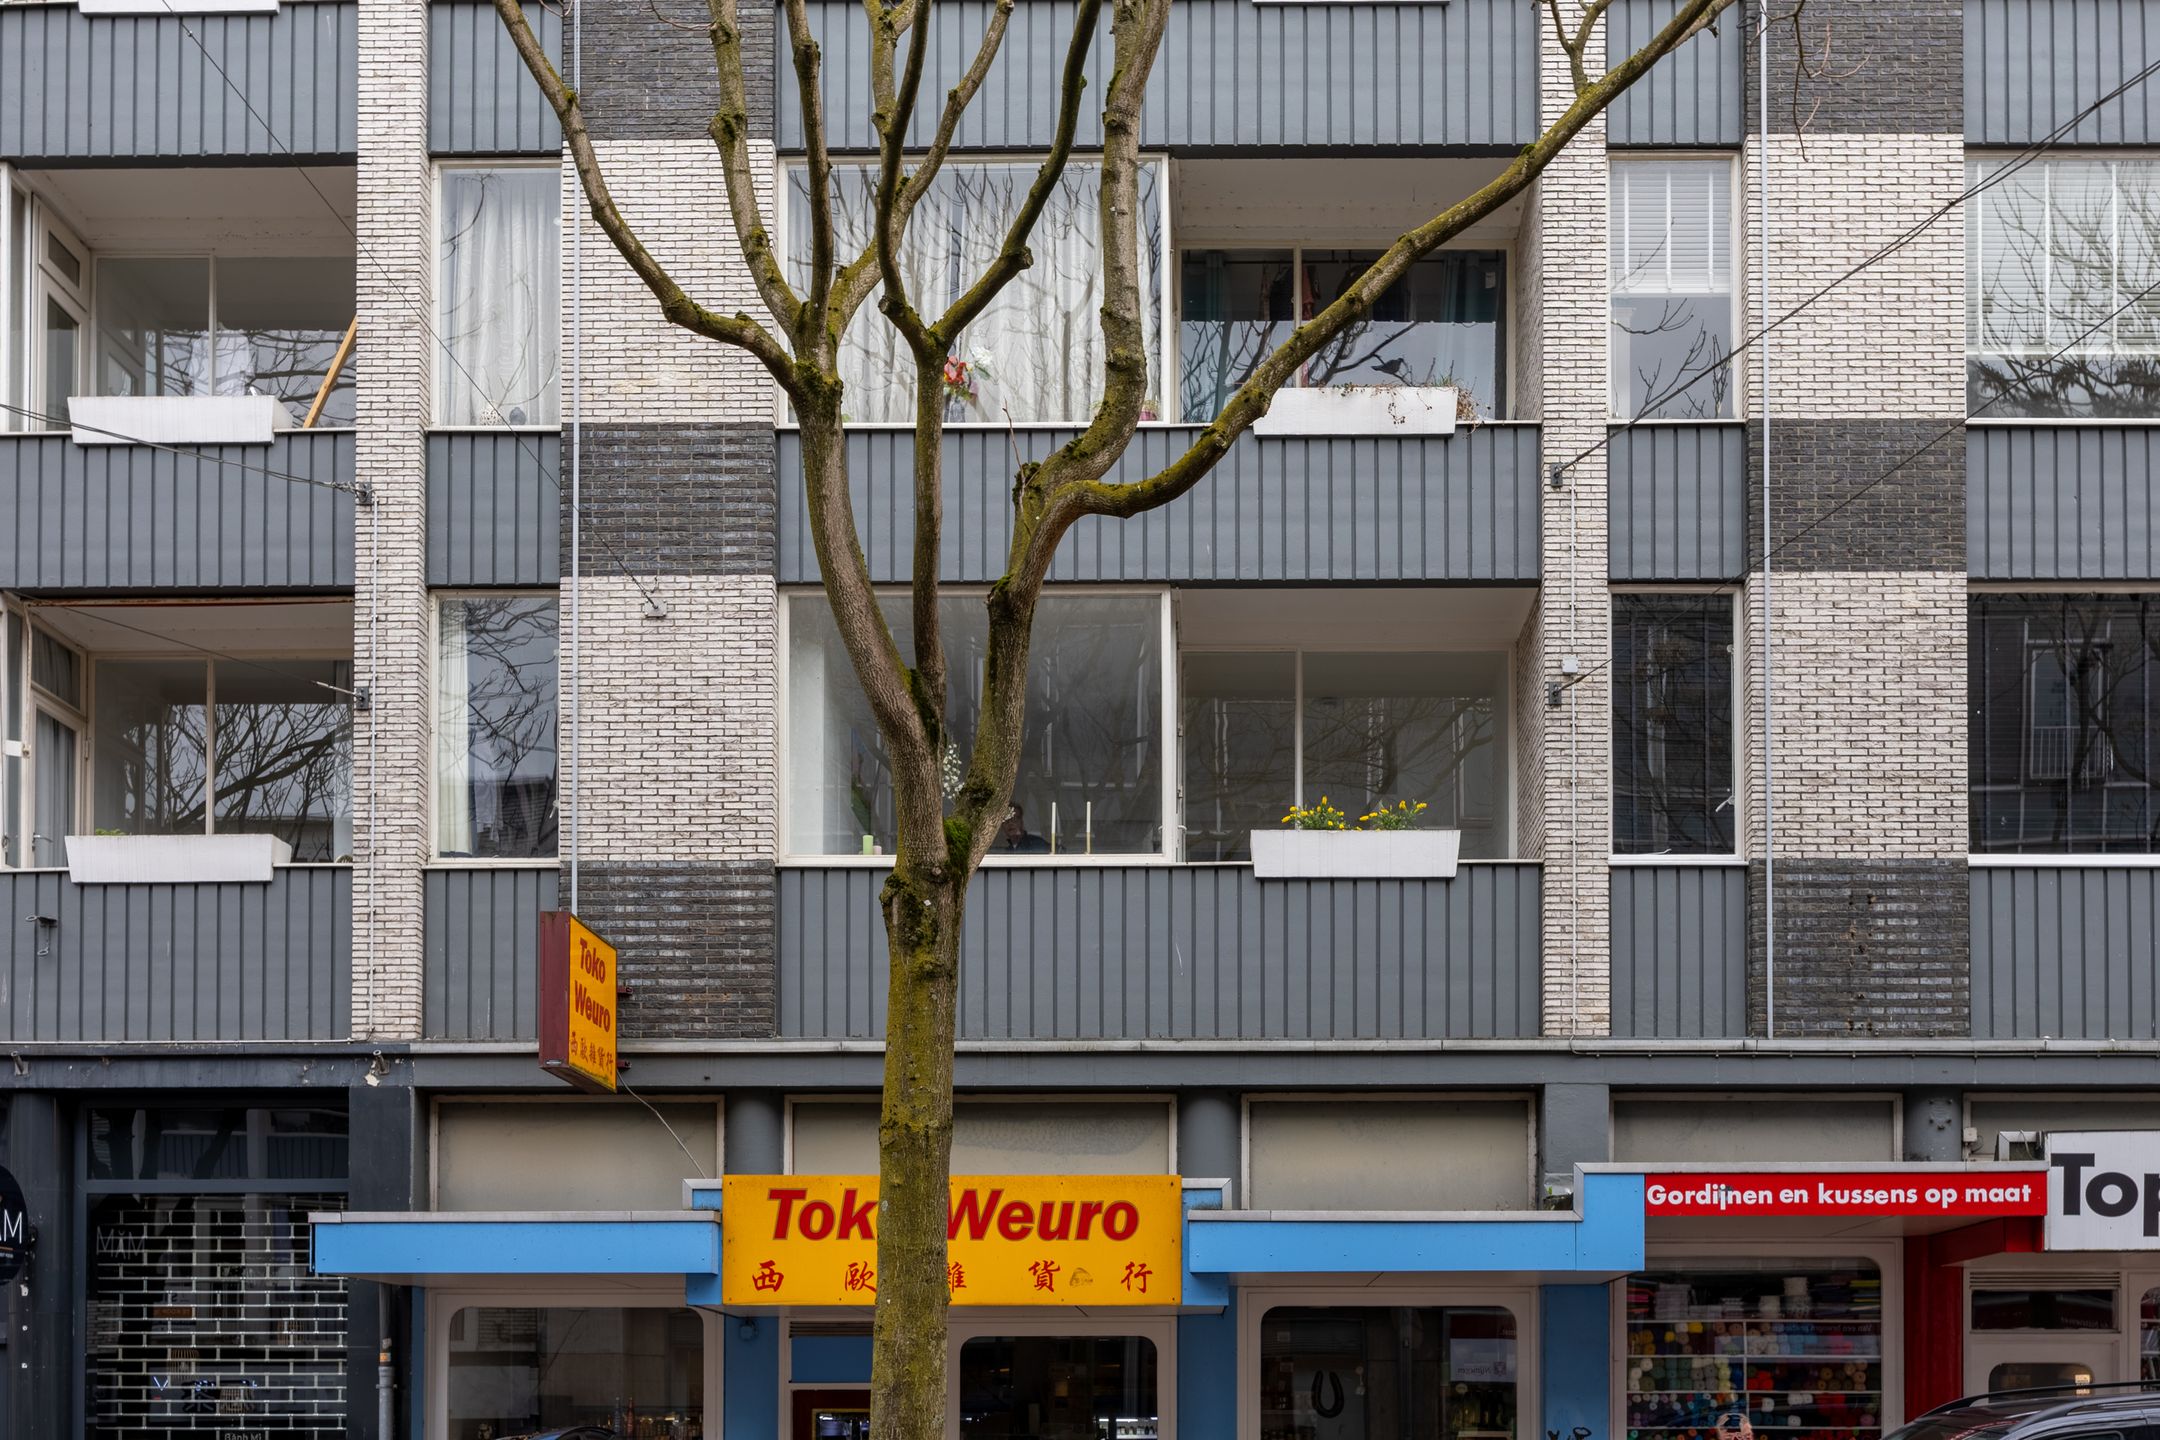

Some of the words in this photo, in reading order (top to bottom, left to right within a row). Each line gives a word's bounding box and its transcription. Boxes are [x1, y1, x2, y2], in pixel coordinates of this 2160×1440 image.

[580, 937, 606, 984] Toko
[574, 980, 611, 1033] Weuro
[768, 1188, 877, 1241] Tok
[946, 1188, 1139, 1241] Weuro
[1646, 1183, 1773, 1210] Gordijnen
[1779, 1188, 1809, 1204] en
[1818, 1182, 1918, 1205] kussens
[1924, 1188, 1958, 1209] op
[1965, 1184, 2032, 1203] maat
